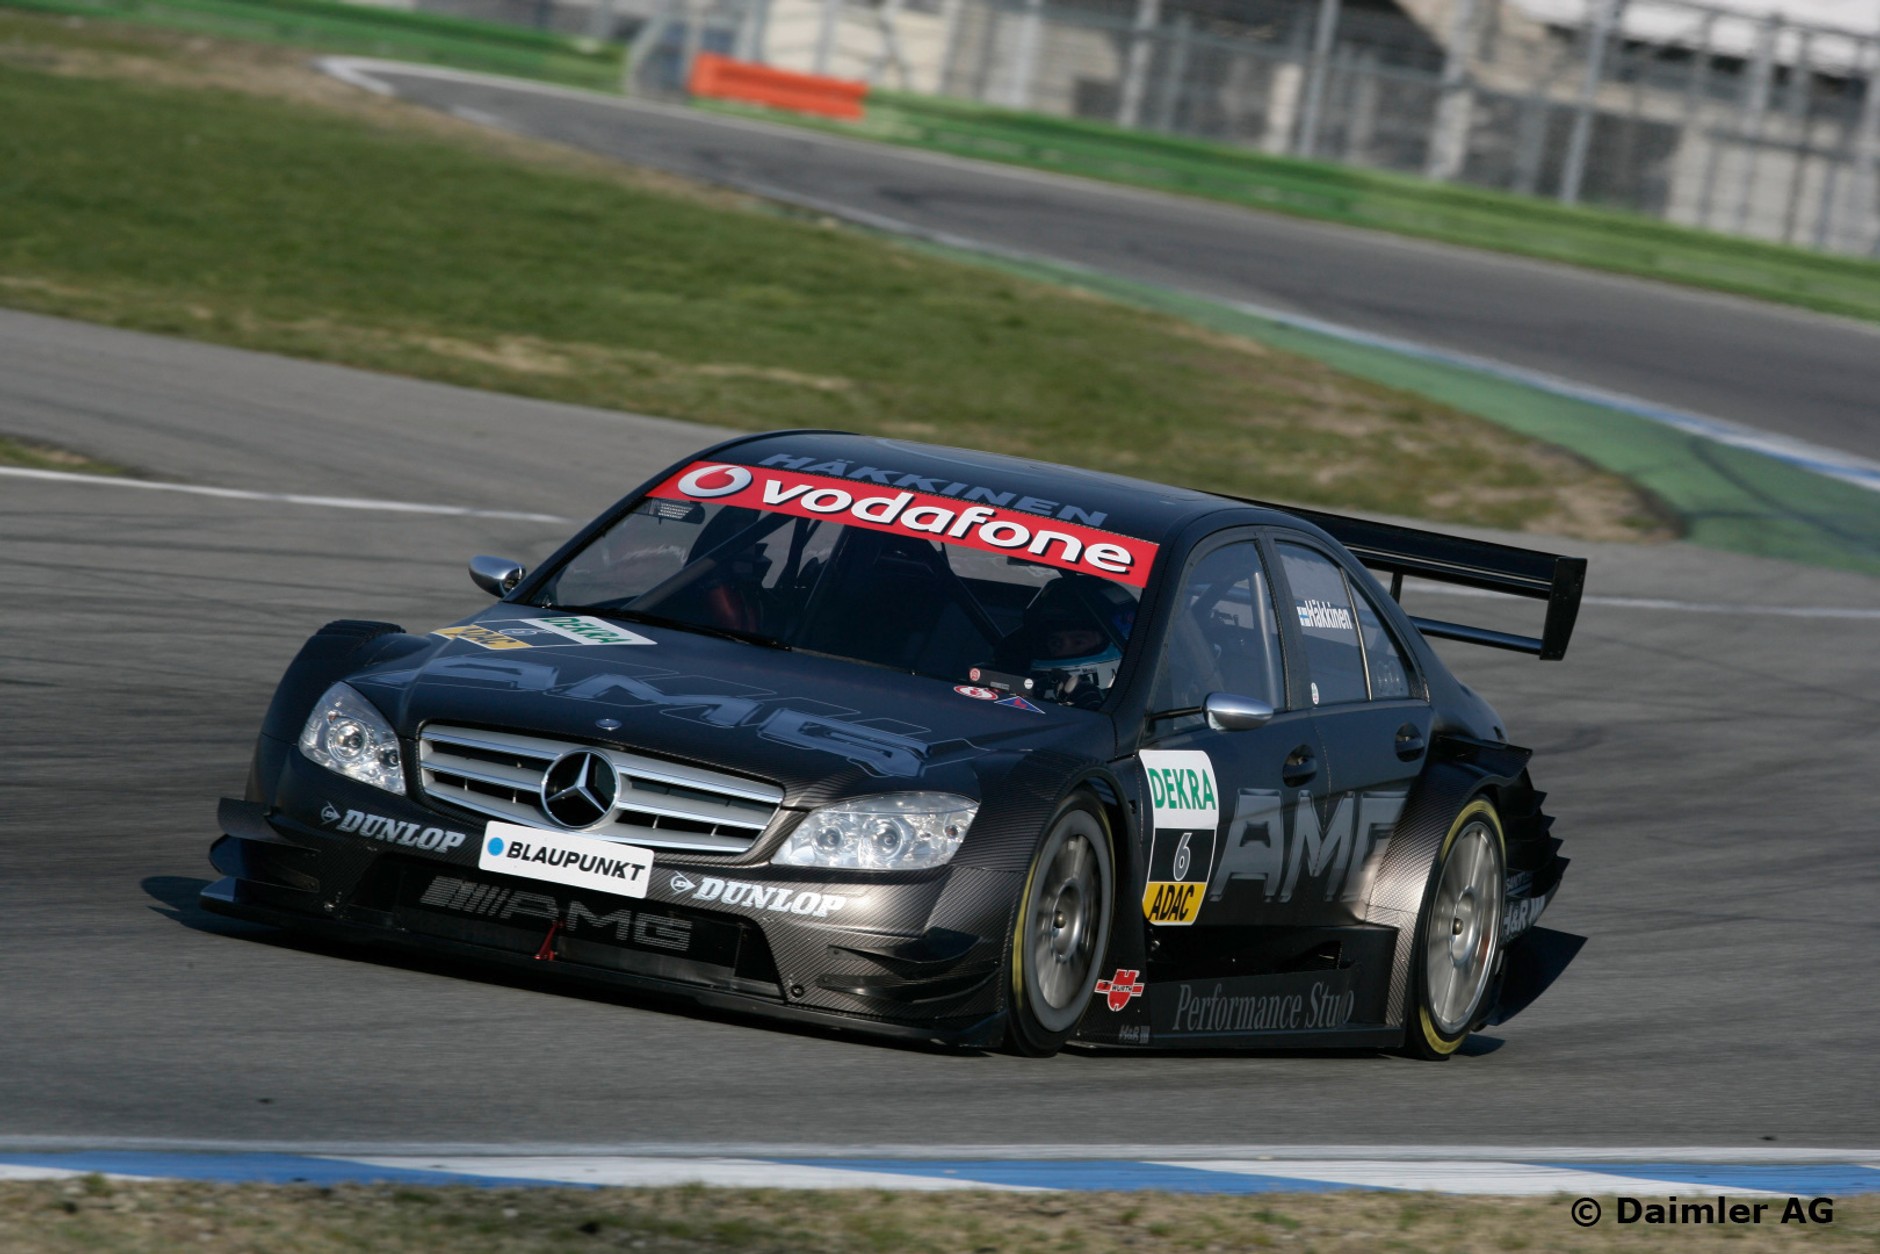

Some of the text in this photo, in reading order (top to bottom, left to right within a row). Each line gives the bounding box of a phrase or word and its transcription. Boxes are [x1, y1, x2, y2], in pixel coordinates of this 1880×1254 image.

[758, 453, 1108, 526] HÄKKINEN
[761, 479, 1134, 573] vodafone
[541, 617, 633, 644] DEKRA
[1304, 599, 1353, 629] Häkkinen
[1147, 768, 1217, 810] DEKRA
[336, 808, 466, 854] DUNLOP
[506, 841, 645, 882] BLAUPUNKT
[1173, 832, 1193, 882] 6
[691, 876, 847, 918] DUNLOP
[1148, 884, 1195, 921] ADAC
[1172, 983, 1303, 1031] Performance
